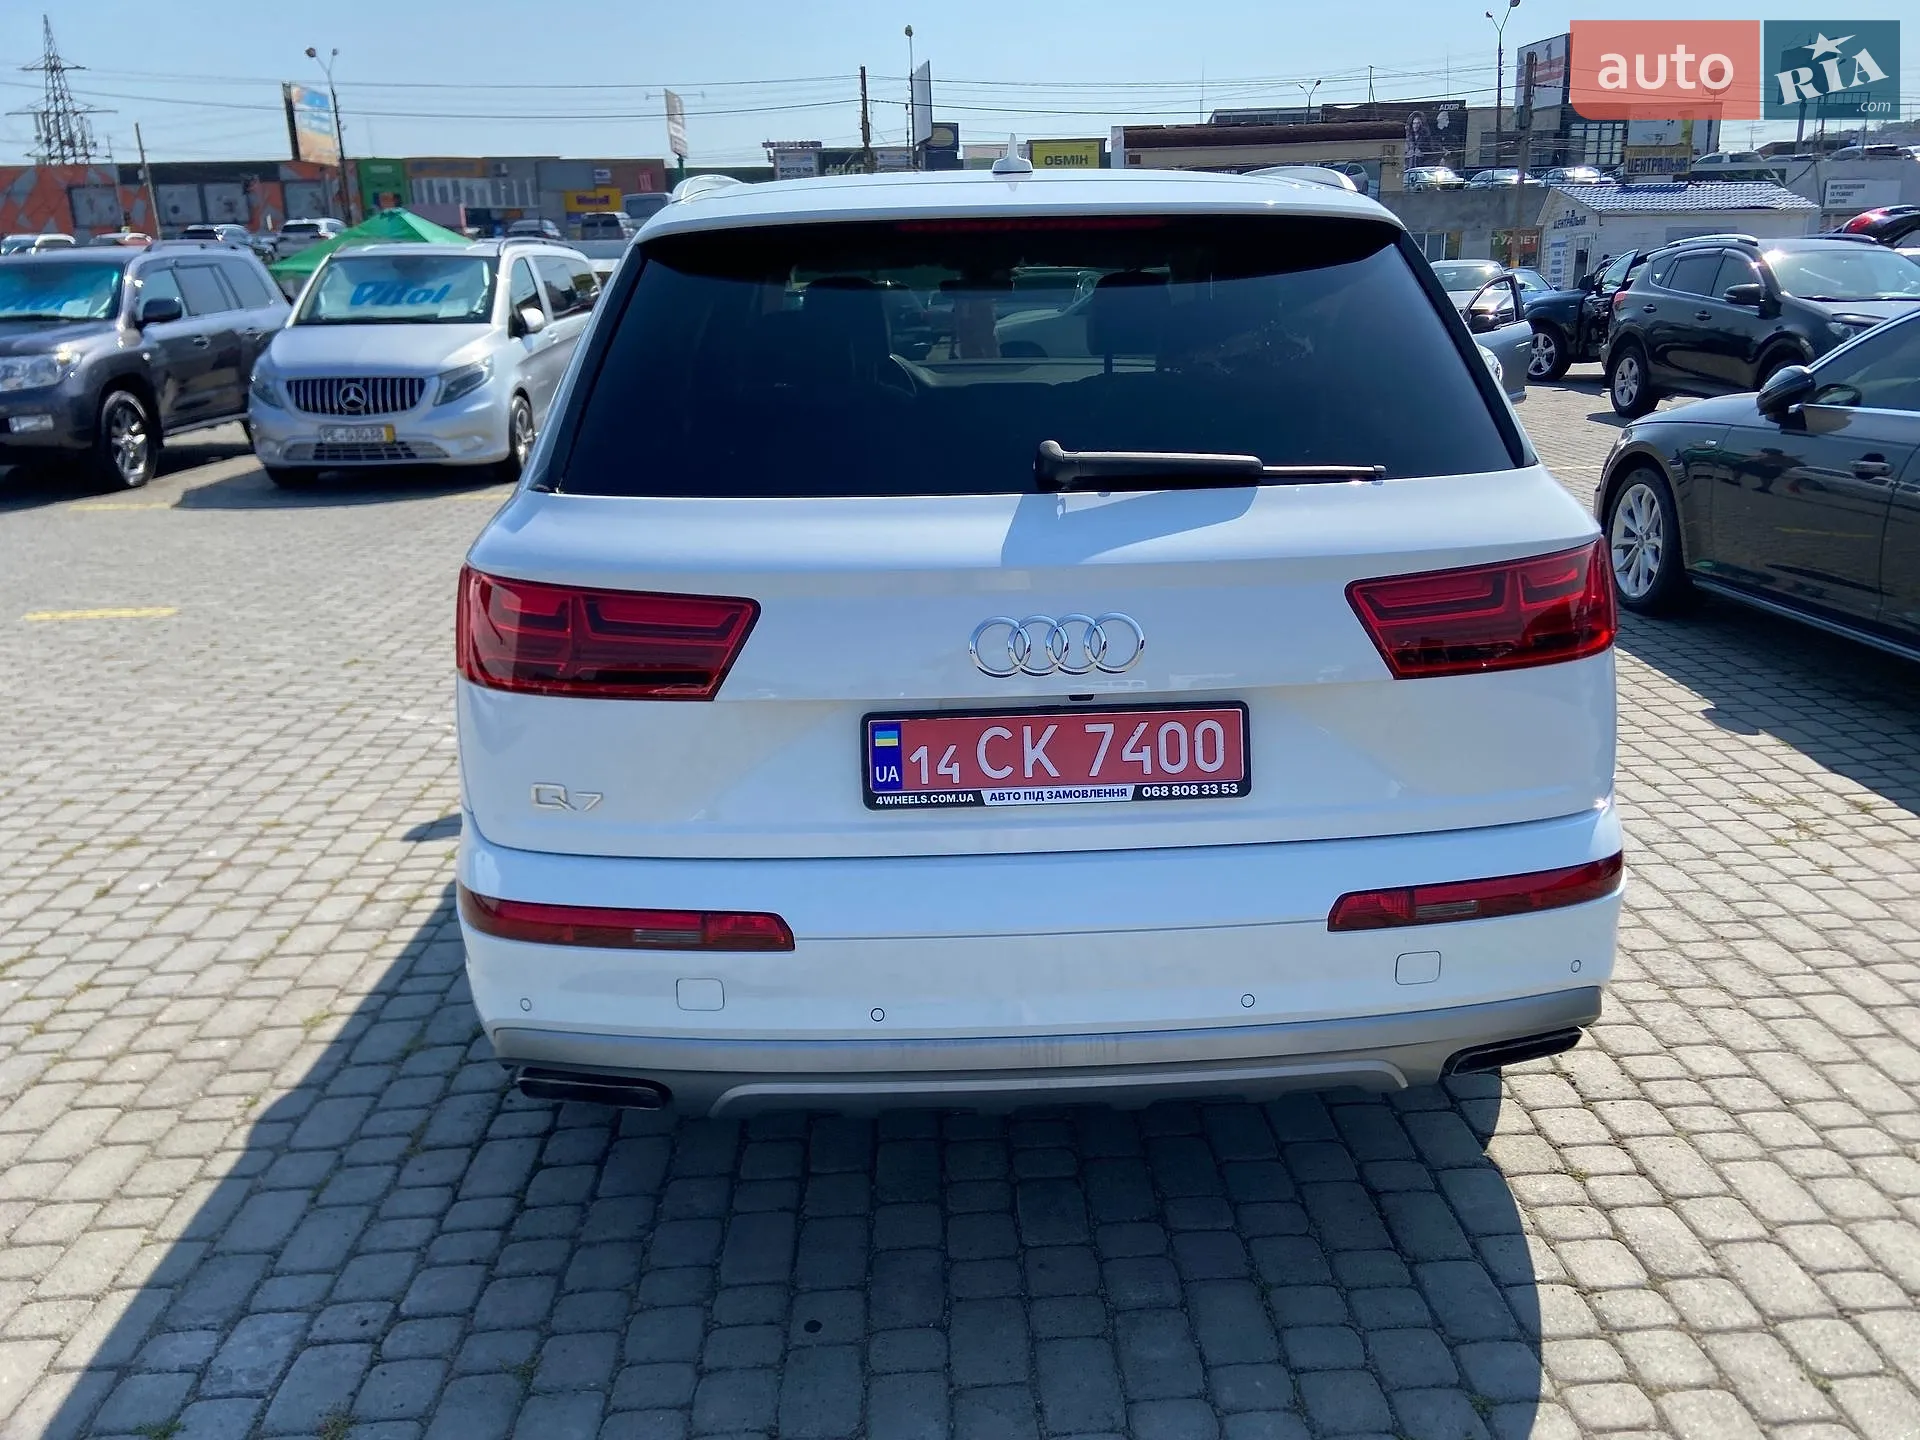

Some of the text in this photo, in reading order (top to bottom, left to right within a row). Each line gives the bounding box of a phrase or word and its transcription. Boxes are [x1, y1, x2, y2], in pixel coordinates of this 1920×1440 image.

[1044, 154, 1088, 166] ОБМІН
[908, 744, 960, 786] 14
[1084, 719, 1225, 778] 7400
[875, 765, 899, 783] UA
[530, 782, 604, 813] Q7
[875, 792, 975, 805] 4WHEELS.COM.UA
[989, 786, 1128, 802] АВТО ПІД ЗАМОВЛЕННЯ
[1141, 783, 1239, 798] 068 808 33 53
